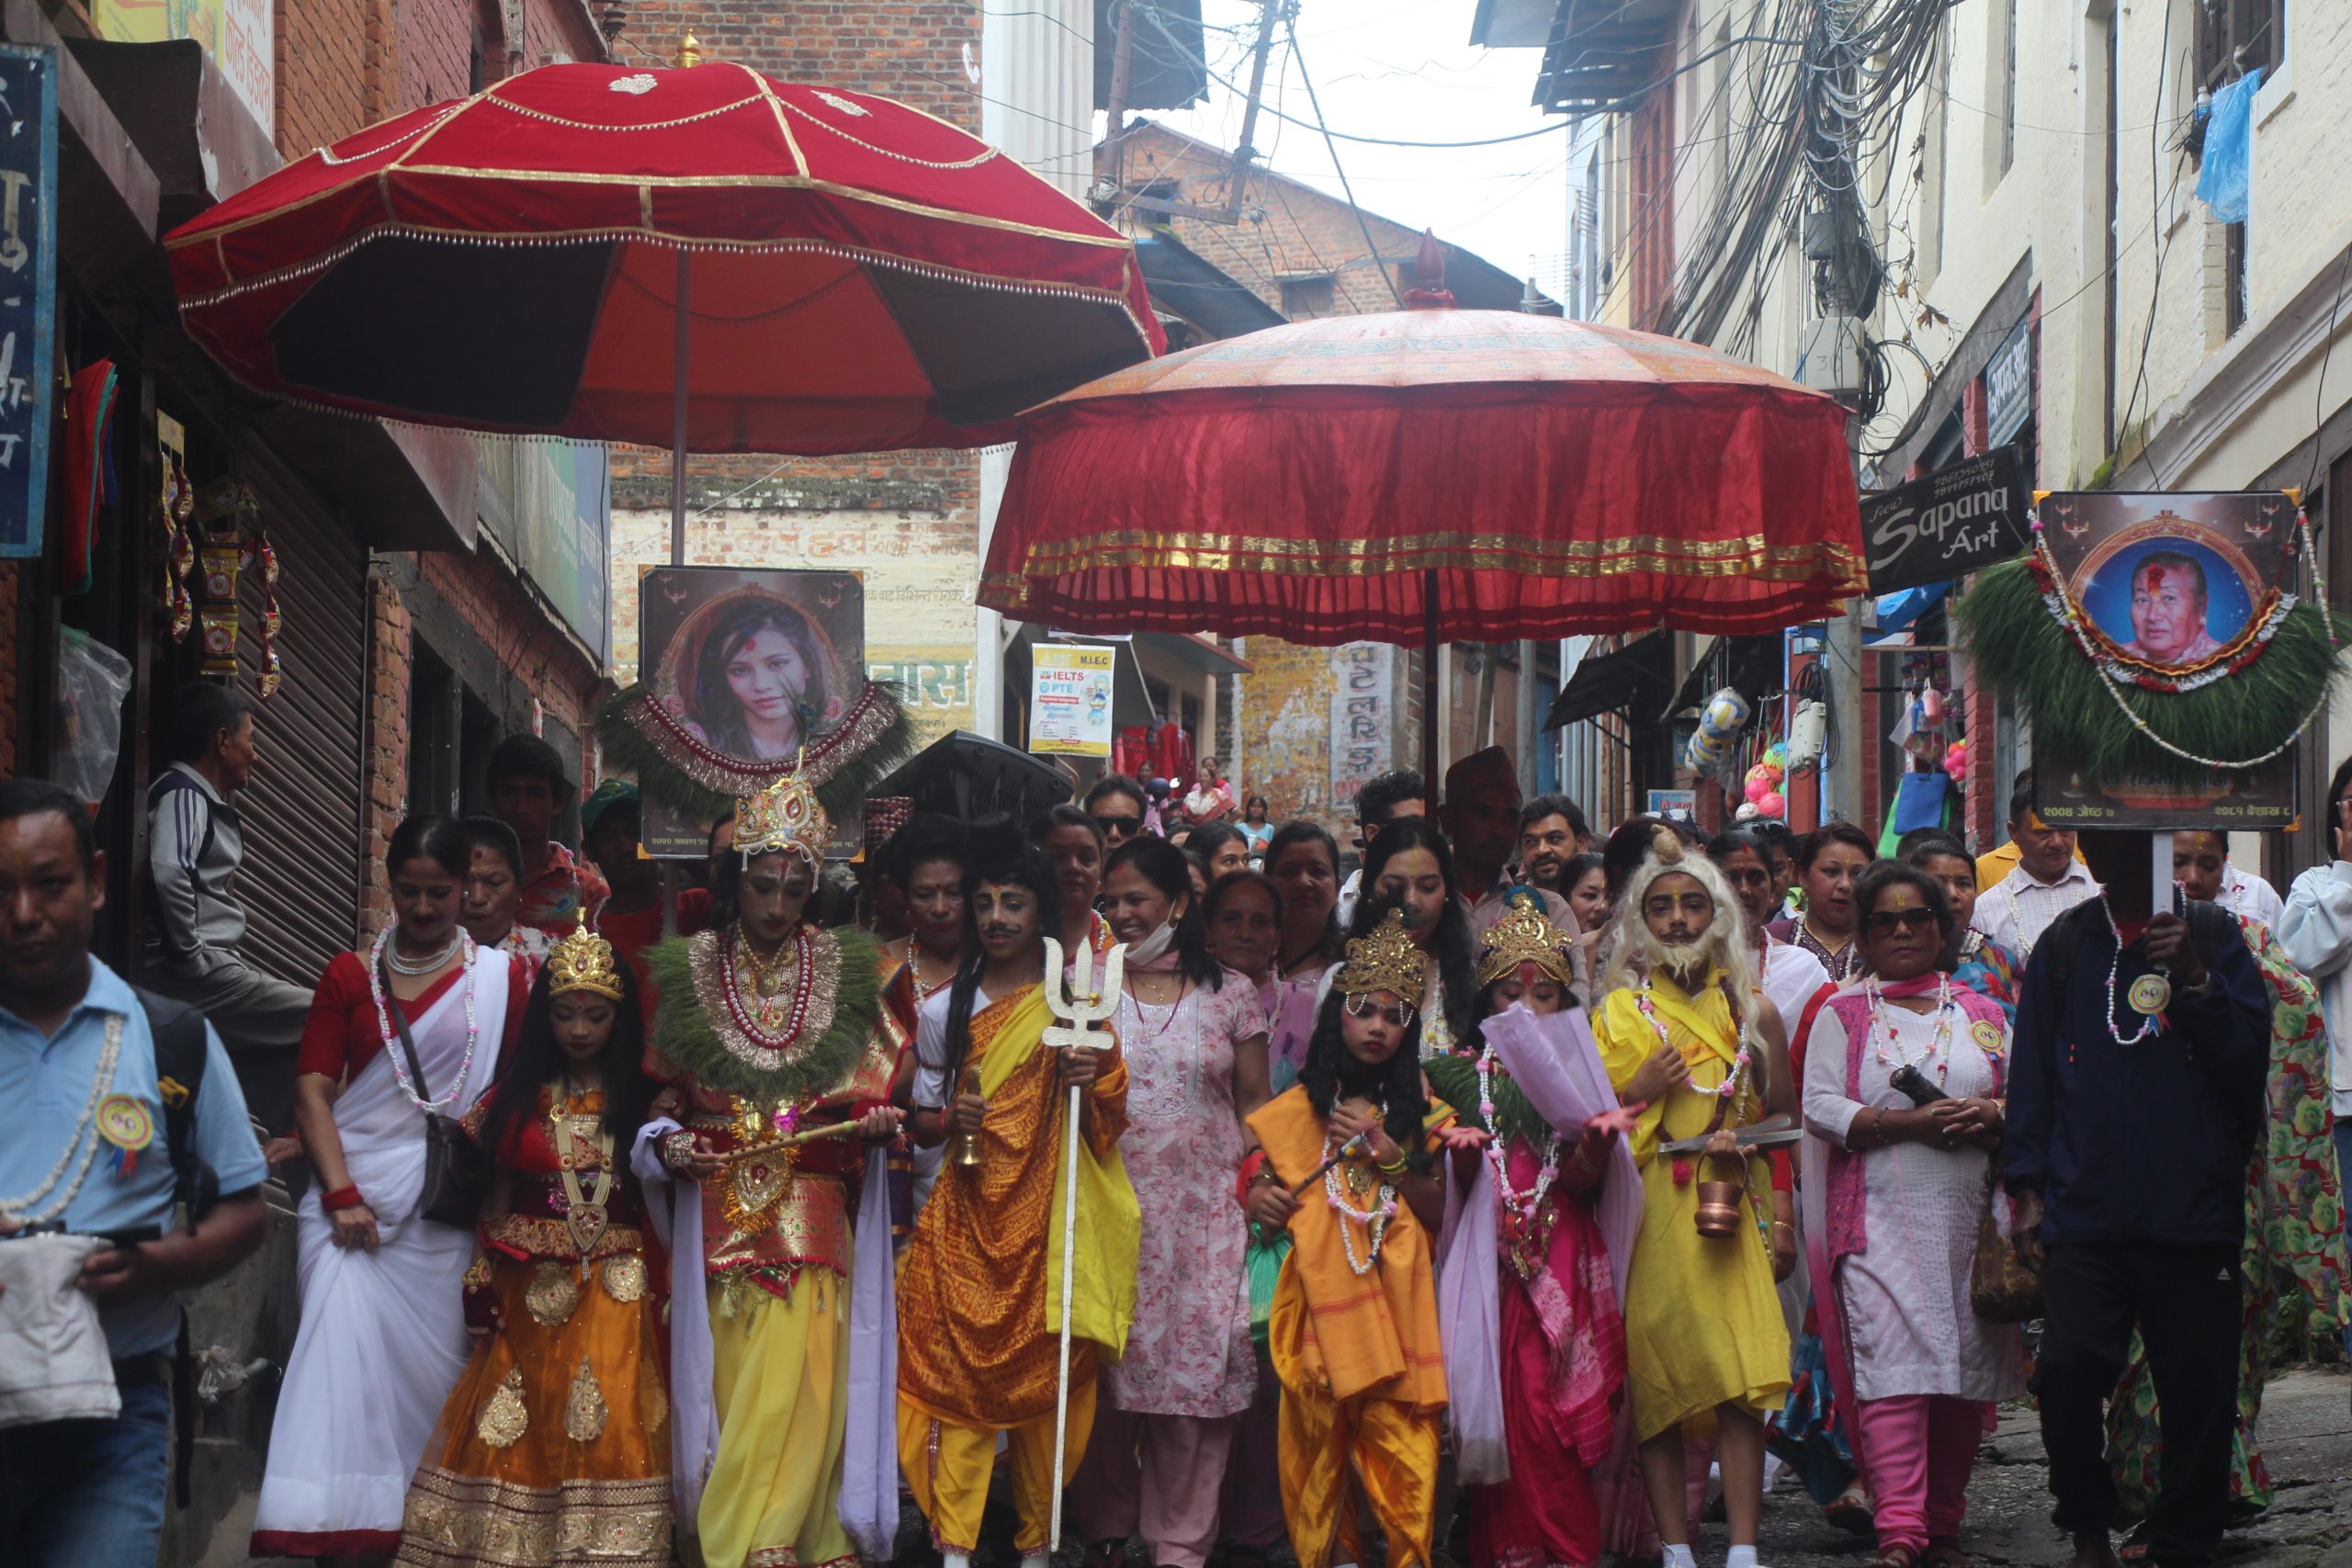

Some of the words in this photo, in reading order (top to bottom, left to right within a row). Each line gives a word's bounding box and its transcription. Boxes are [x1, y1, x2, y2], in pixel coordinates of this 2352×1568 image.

[1870, 487, 2008, 570] Sapana
[1941, 520, 1999, 558] Art
[1052, 684, 1073, 693] PTE
[1053, 671, 1084, 682] IELTS
